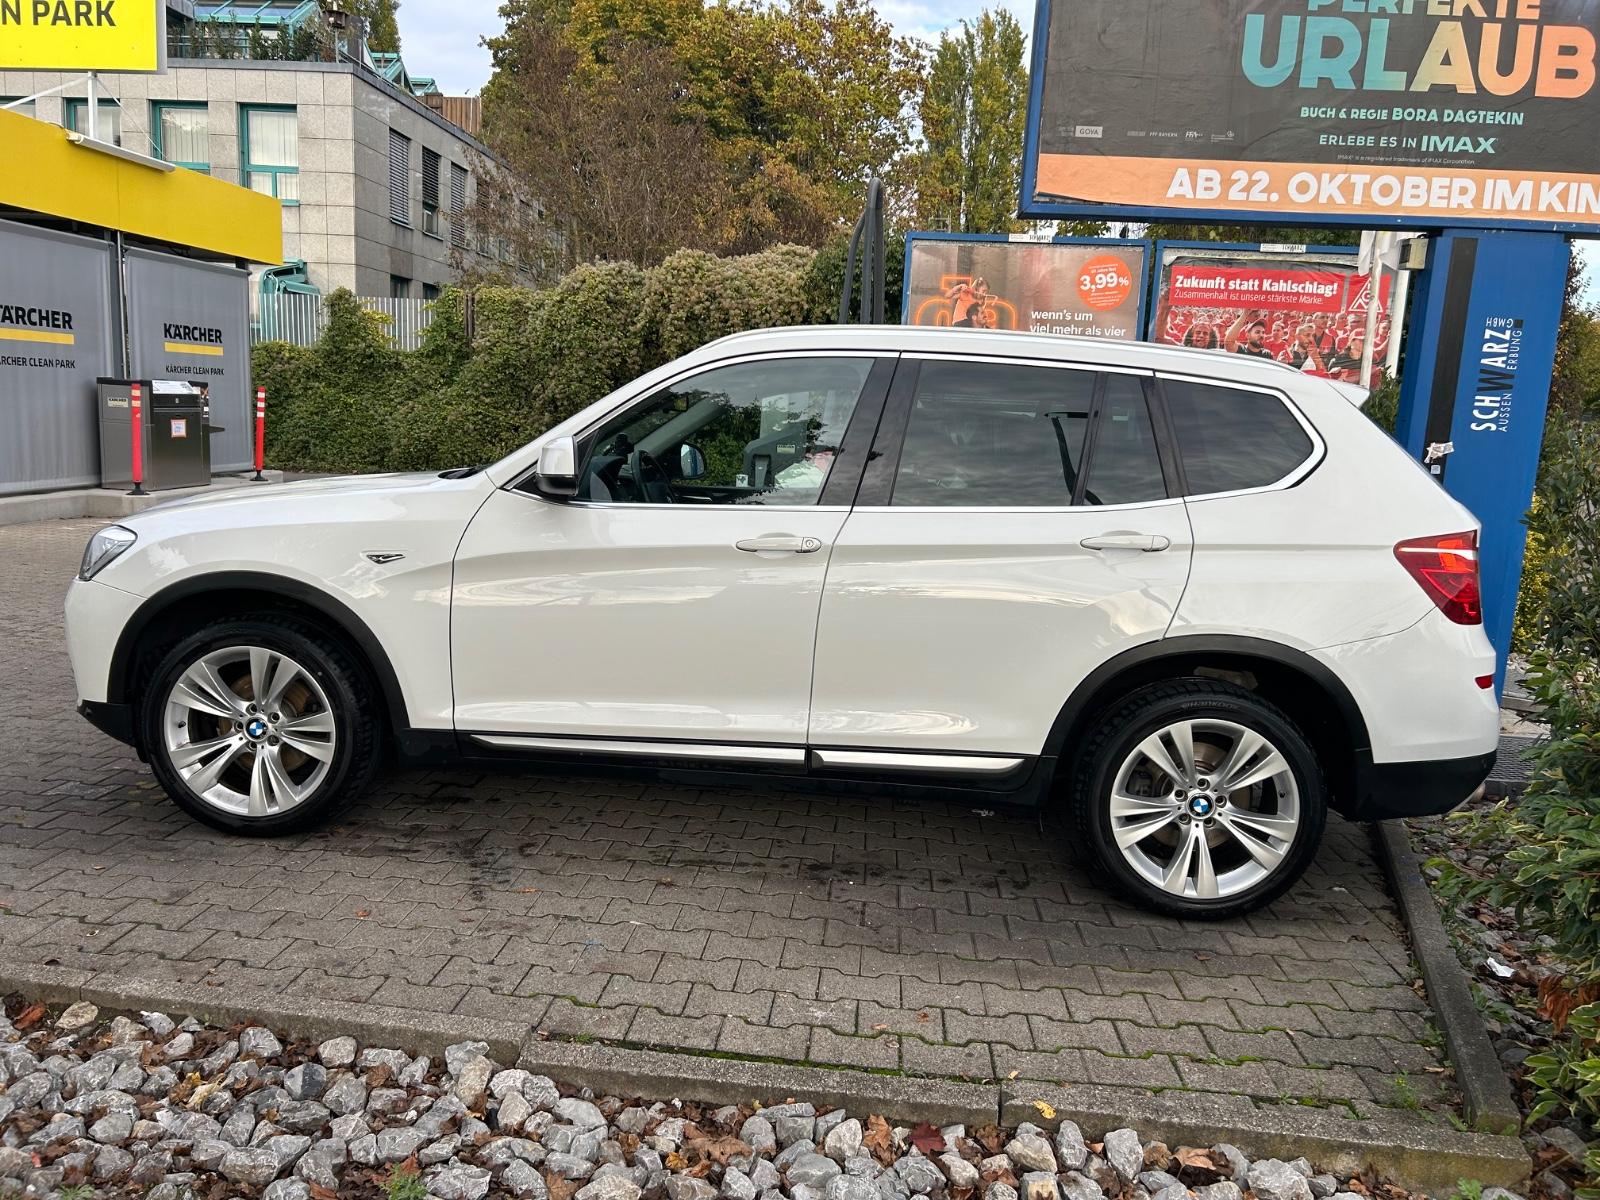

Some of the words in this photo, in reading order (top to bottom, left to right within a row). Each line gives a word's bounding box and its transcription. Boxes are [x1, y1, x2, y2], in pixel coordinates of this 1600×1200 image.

[33, 0, 117, 26] PARK
[1241, 14, 1597, 98] URLAUB
[1300, 106, 1336, 119] BUCH
[1338, 108, 1347, 119] &
[1350, 109, 1389, 120] REGIE
[1391, 107, 1439, 122] BORA
[1443, 109, 1524, 126] DAGTEKIN
[1319, 134, 1375, 147] ERLEBE
[1379, 136, 1398, 148] ES
[1402, 137, 1417, 148] IN
[1420, 135, 1497, 154] IMAX
[1166, 168, 1221, 199] AB
[1227, 169, 1279, 202] 22.
[1287, 171, 1477, 209] OKTOBER
[1482, 179, 1534, 211] IM
[1175, 275, 1226, 289] Zukunft
[1228, 278, 1260, 291] statt
[1262, 278, 1338, 298] Kahlschlag!
[0, 304, 73, 329] ÄRCHER
[1074, 312, 1093, 321] um
[163, 322, 223, 343] KÄRCHER
[1052, 323, 1083, 335] mehr
[1085, 325, 1102, 336] als
[1104, 325, 1126, 337] vier
[0, 355, 27, 367] RCHER
[29, 357, 54, 368] CLEAN
[55, 359, 76, 369] PARK
[193, 366, 210, 375] CLEAN
[1470, 328, 1515, 431] SCHWARZ
